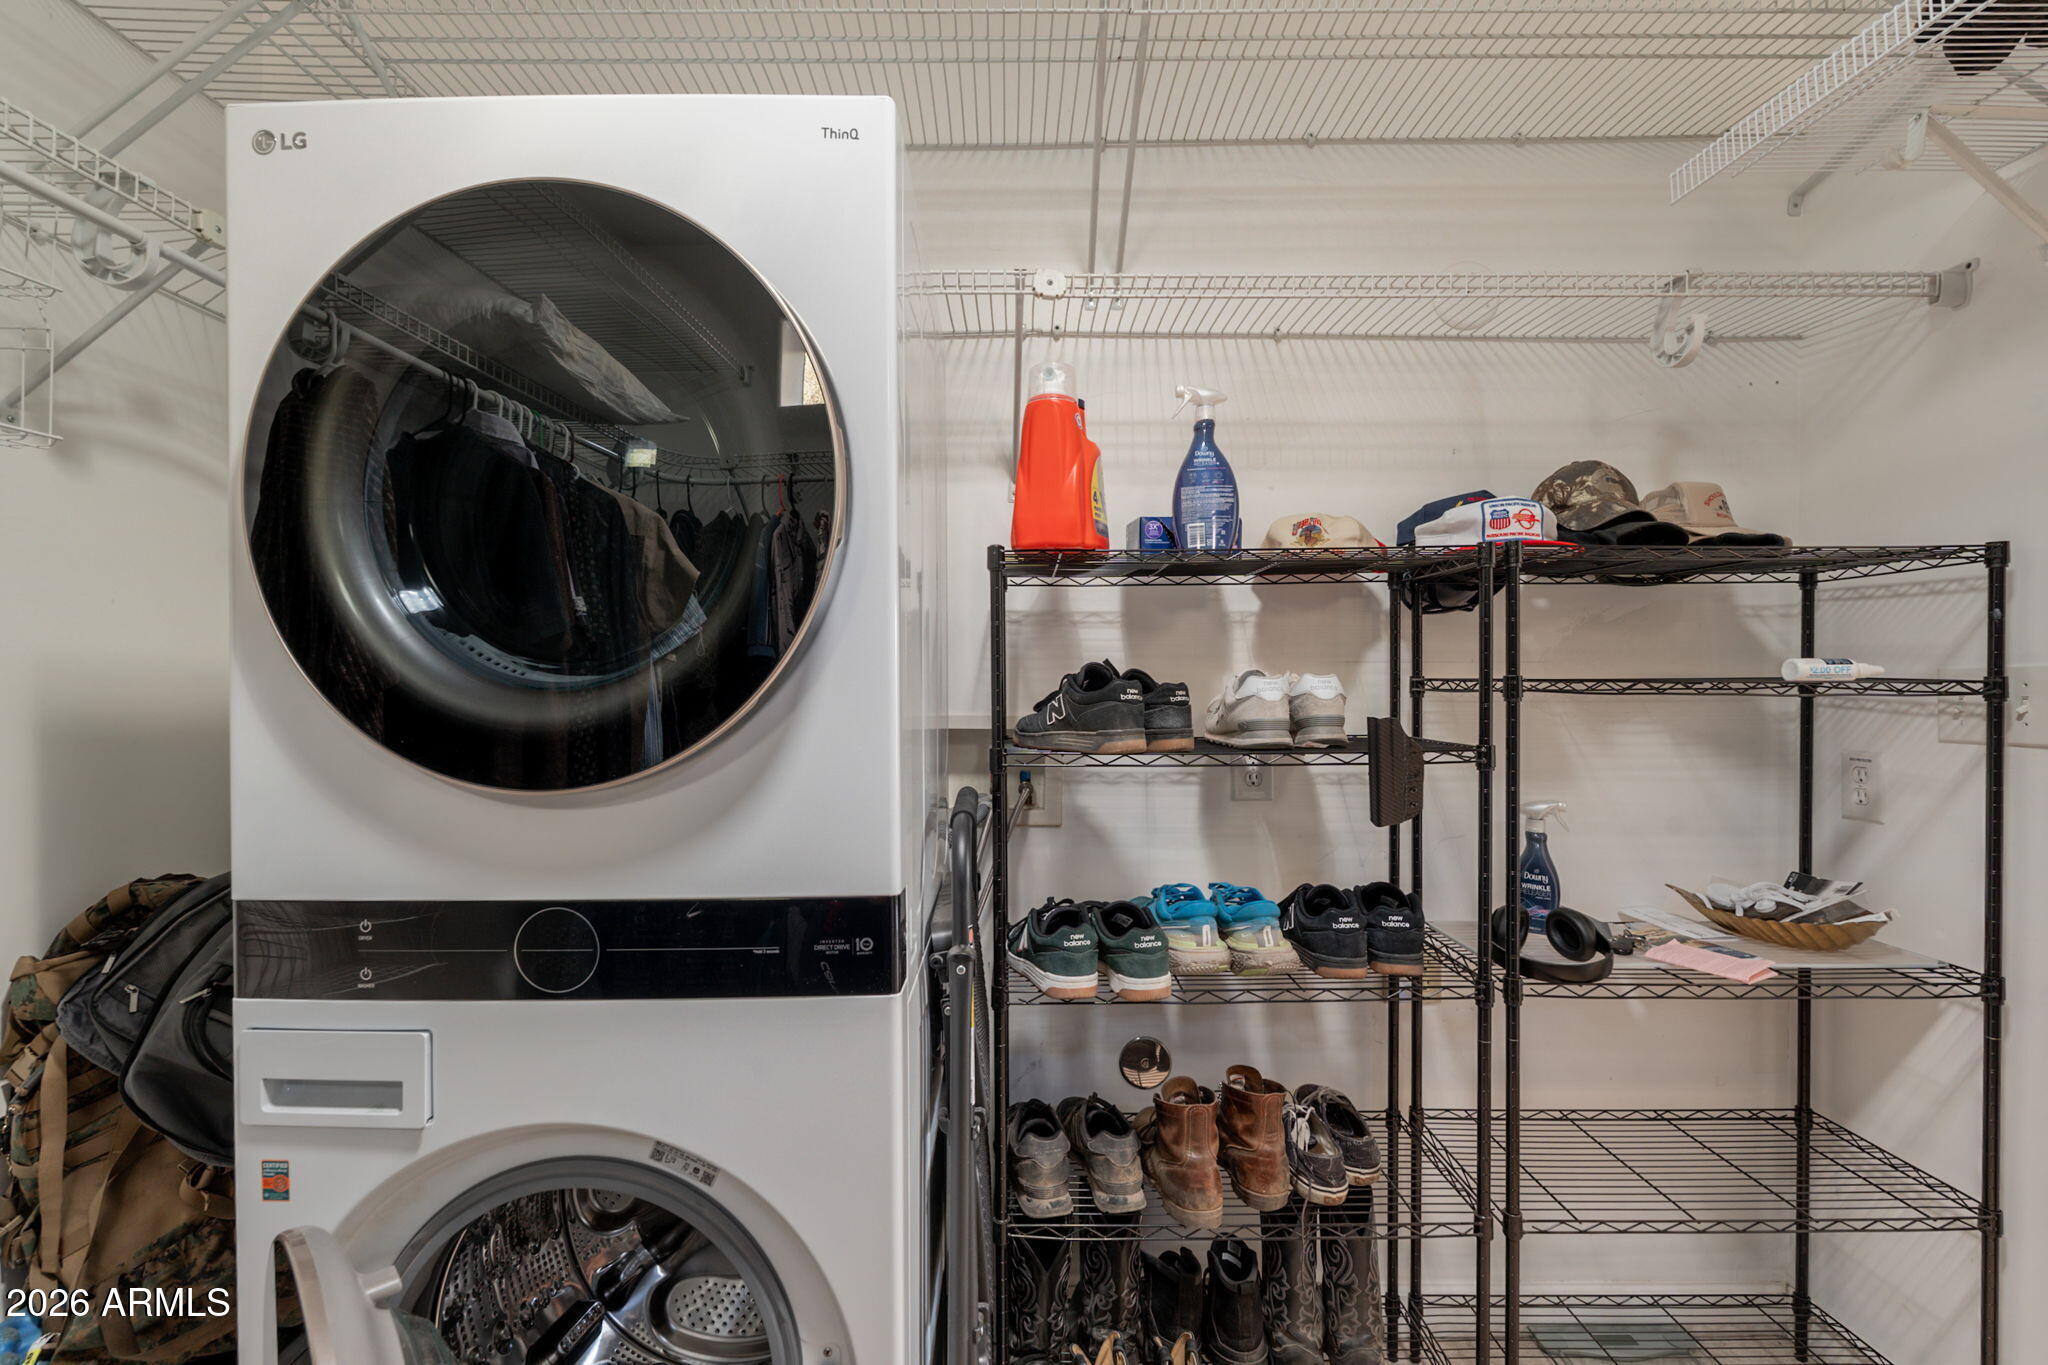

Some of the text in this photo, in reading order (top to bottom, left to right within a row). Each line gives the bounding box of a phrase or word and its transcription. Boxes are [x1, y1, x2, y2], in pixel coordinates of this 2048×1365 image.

[821, 127, 860, 140] ThinQ
[280, 131, 307, 150] LG
[1833, 665, 1852, 673] OFF
[1524, 872, 1549, 884] Downy
[1522, 883, 1550, 892] WRINKLE
[1381, 920, 1410, 928] balance
[855, 937, 874, 951] 10
[1063, 939, 1091, 947] balance
[1134, 940, 1162, 949] balance
